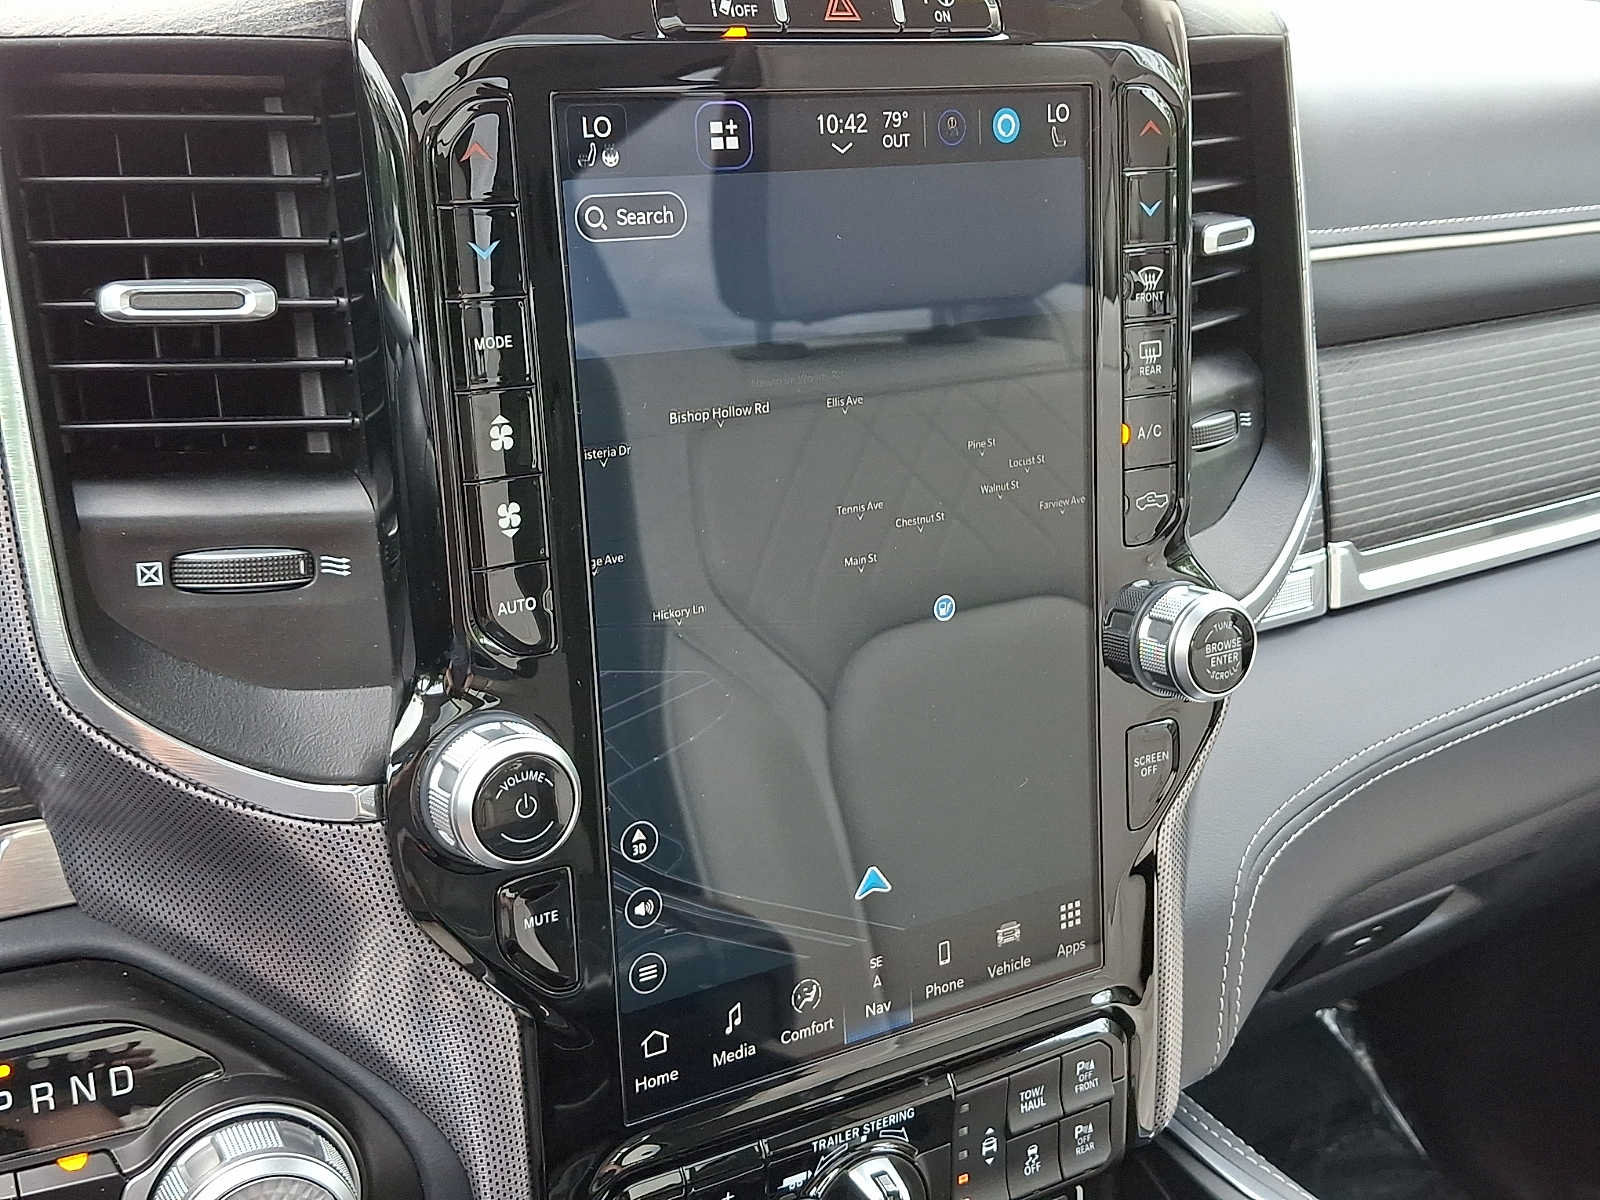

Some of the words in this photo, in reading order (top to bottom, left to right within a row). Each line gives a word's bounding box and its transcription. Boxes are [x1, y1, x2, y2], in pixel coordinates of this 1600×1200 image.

[735, 5, 758, 18] OFF
[934, 11, 951, 23] ON
[882, 111, 909, 129] 79°
[1047, 104, 1070, 123] LO
[582, 116, 612, 139] LO
[816, 113, 868, 135] 10:42
[882, 133, 911, 149] OUT
[616, 206, 674, 227] Search
[1135, 290, 1164, 304] FRONT
[474, 334, 513, 350] MODE
[1139, 364, 1162, 376] REAR
[826, 396, 844, 408] Ellis
[845, 394, 864, 406] Ave
[669, 408, 710, 427] Bishop
[712, 404, 751, 421] Hollow
[753, 401, 770, 416] Rd
[1137, 423, 1162, 439] A/C
[618, 444, 632, 457] Dr
[967, 440, 985, 451] Pine
[985, 438, 997, 448] St
[1009, 456, 1036, 468] Locust
[1036, 454, 1046, 465] St
[980, 482, 1010, 495] Walnut
[1010, 480, 1020, 491] St
[836, 503, 865, 516] Tennis
[866, 500, 884, 512] Ave
[1039, 497, 1070, 510] Farview
[1070, 496, 1086, 507] Ave
[895, 514, 935, 529] Chestnut
[935, 511, 945, 524] St
[604, 553, 624, 565] Ave
[844, 555, 867, 568] Main
[867, 553, 878, 565] St
[497, 597, 537, 616] AUTO
[652, 607, 691, 623] Hickory
[693, 604, 705, 617] Ln
[1212, 622, 1234, 632] TUNE
[1205, 637, 1242, 655] BROWSE
[1210, 653, 1239, 667] ENTER
[1210, 665, 1238, 681] SCROLL
[1133, 751, 1169, 767] SCREEN
[1140, 765, 1158, 777] OFF
[500, 770, 546, 793] VOLUME
[632, 843, 647, 857] 3D
[523, 910, 560, 930] MUTE
[1057, 938, 1086, 959] Apps
[870, 956, 882, 969] SE
[987, 955, 1032, 979] Vehicle
[925, 977, 964, 999] Phone
[865, 998, 892, 1018] Nav
[780, 1017, 835, 1045] Comfort
[712, 1043, 757, 1067] Media
[634, 1068, 679, 1094] Home
[1078, 1070, 1094, 1084] OFF
[1019, 1084, 1044, 1101] TOW/
[1075, 1077, 1099, 1095] FRONT
[1020, 1096, 1047, 1114] HAUL
[812, 1126, 860, 1152] TRAILER
[862, 1108, 916, 1137] STEERING
[1075, 1139, 1096, 1156] REAR
[1077, 1133, 1092, 1148] OFF
[1024, 1160, 1041, 1176] OFF
